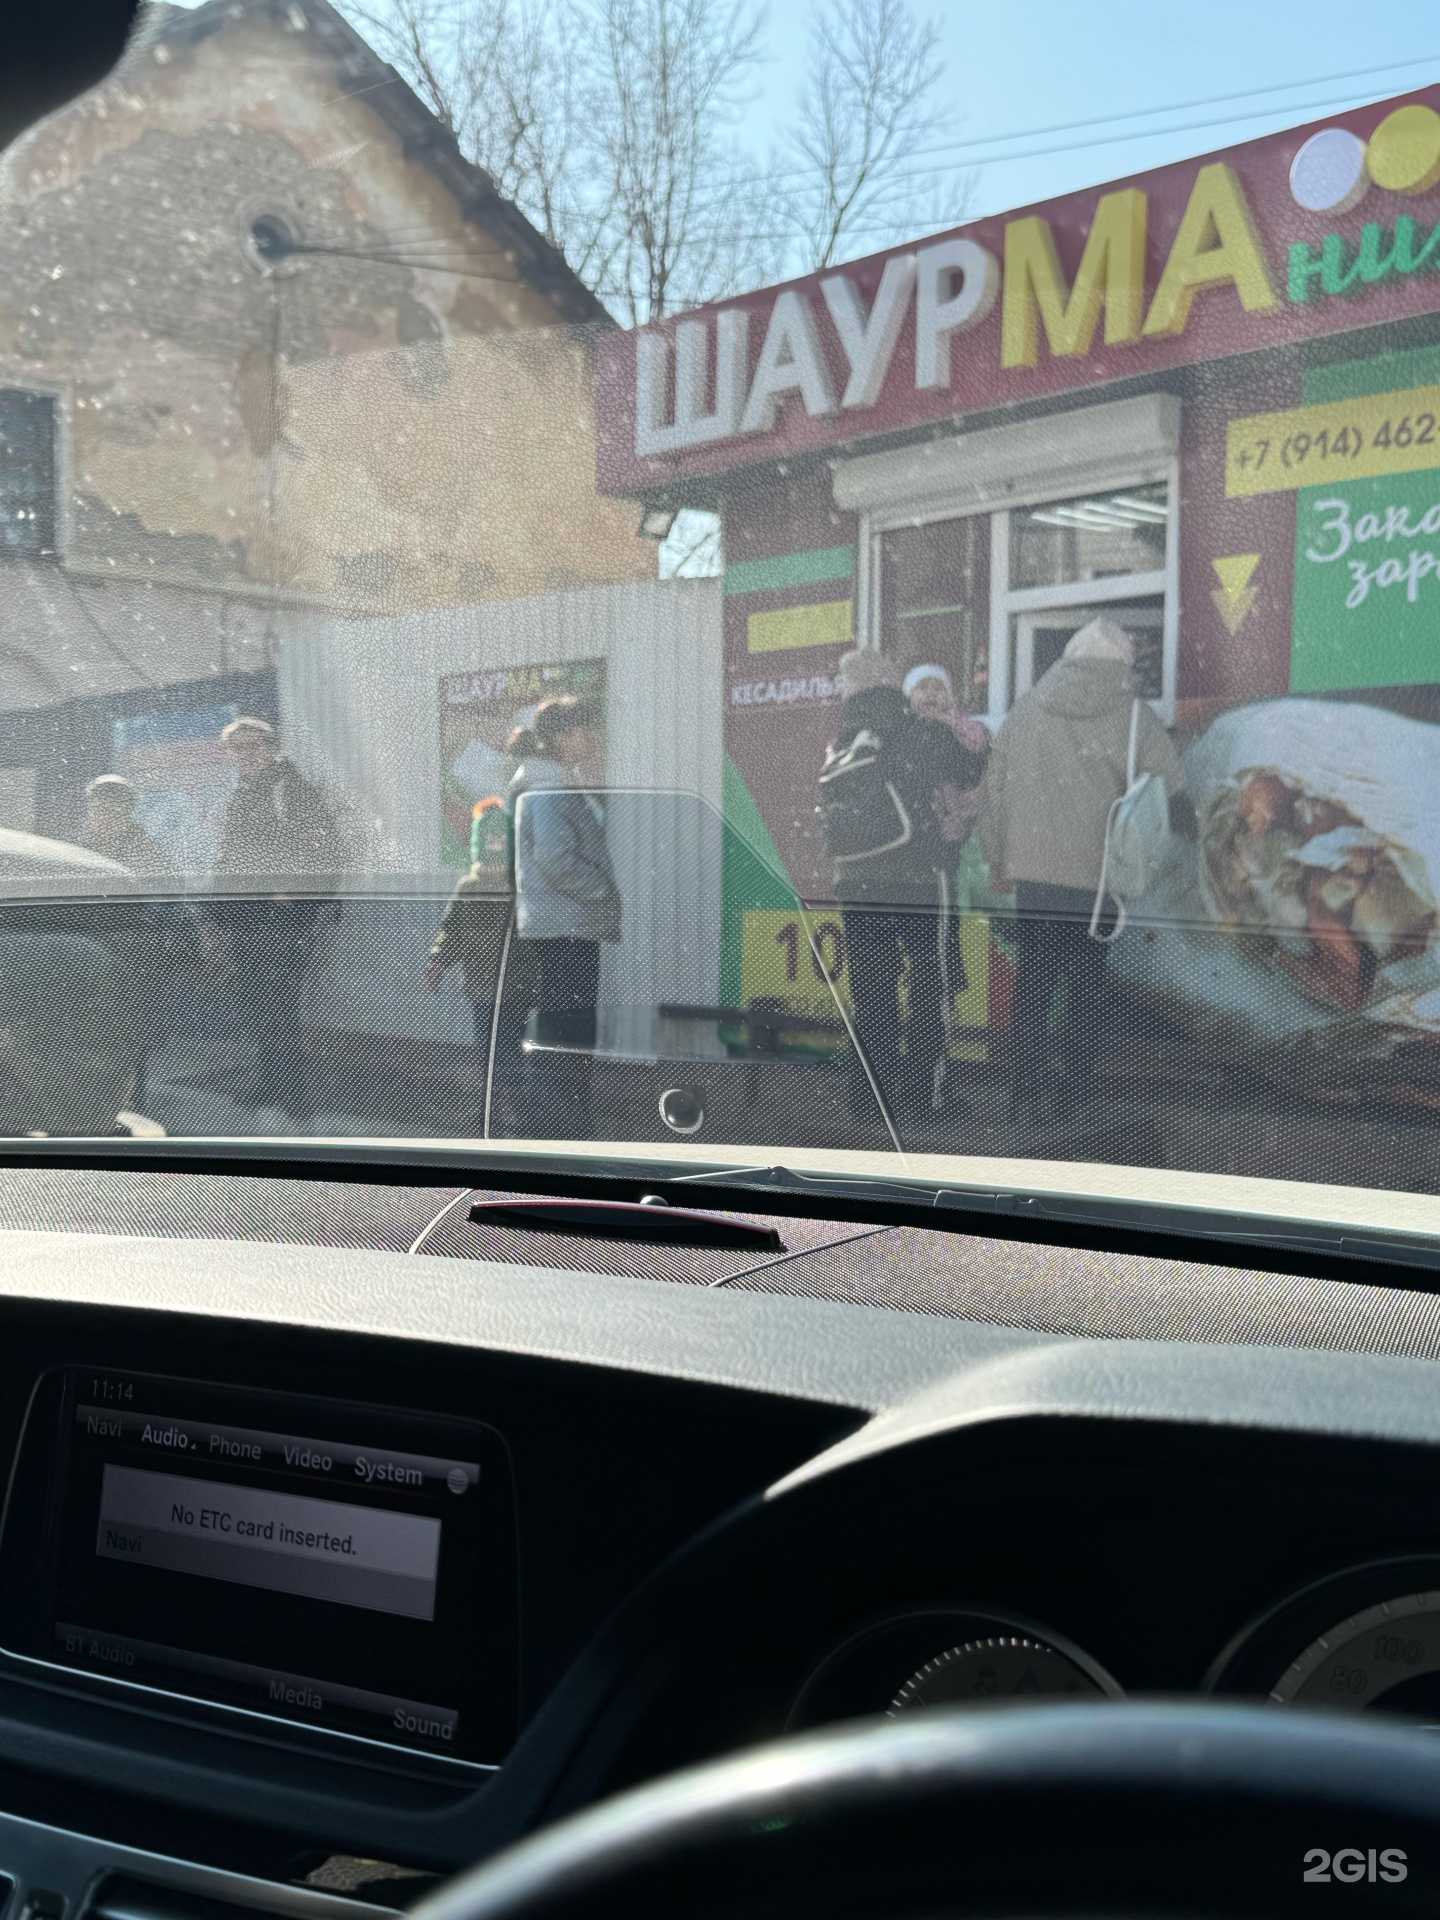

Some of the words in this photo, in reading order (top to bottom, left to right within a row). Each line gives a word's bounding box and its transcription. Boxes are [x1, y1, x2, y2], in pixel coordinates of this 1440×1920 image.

[634, 161, 1280, 458] ШАУРМА
[1286, 213, 1440, 304] ни
[1234, 438, 1271, 471] +7
[1280, 425, 1363, 469] (914)
[1345, 550, 1440, 608] зар
[92, 1379, 134, 1401] 11:14
[87, 1415, 122, 1438] Navi
[209, 1434, 262, 1460] Phone
[283, 1446, 333, 1472] Video
[354, 1457, 423, 1487] System
[105, 1530, 142, 1554] Navi
[171, 1504, 195, 1526] No
[200, 1510, 232, 1533] ETC
[236, 1518, 274, 1541] card
[279, 1524, 358, 1556] inserted.
[269, 1679, 323, 1711] Media
[392, 1707, 454, 1741] Sound
